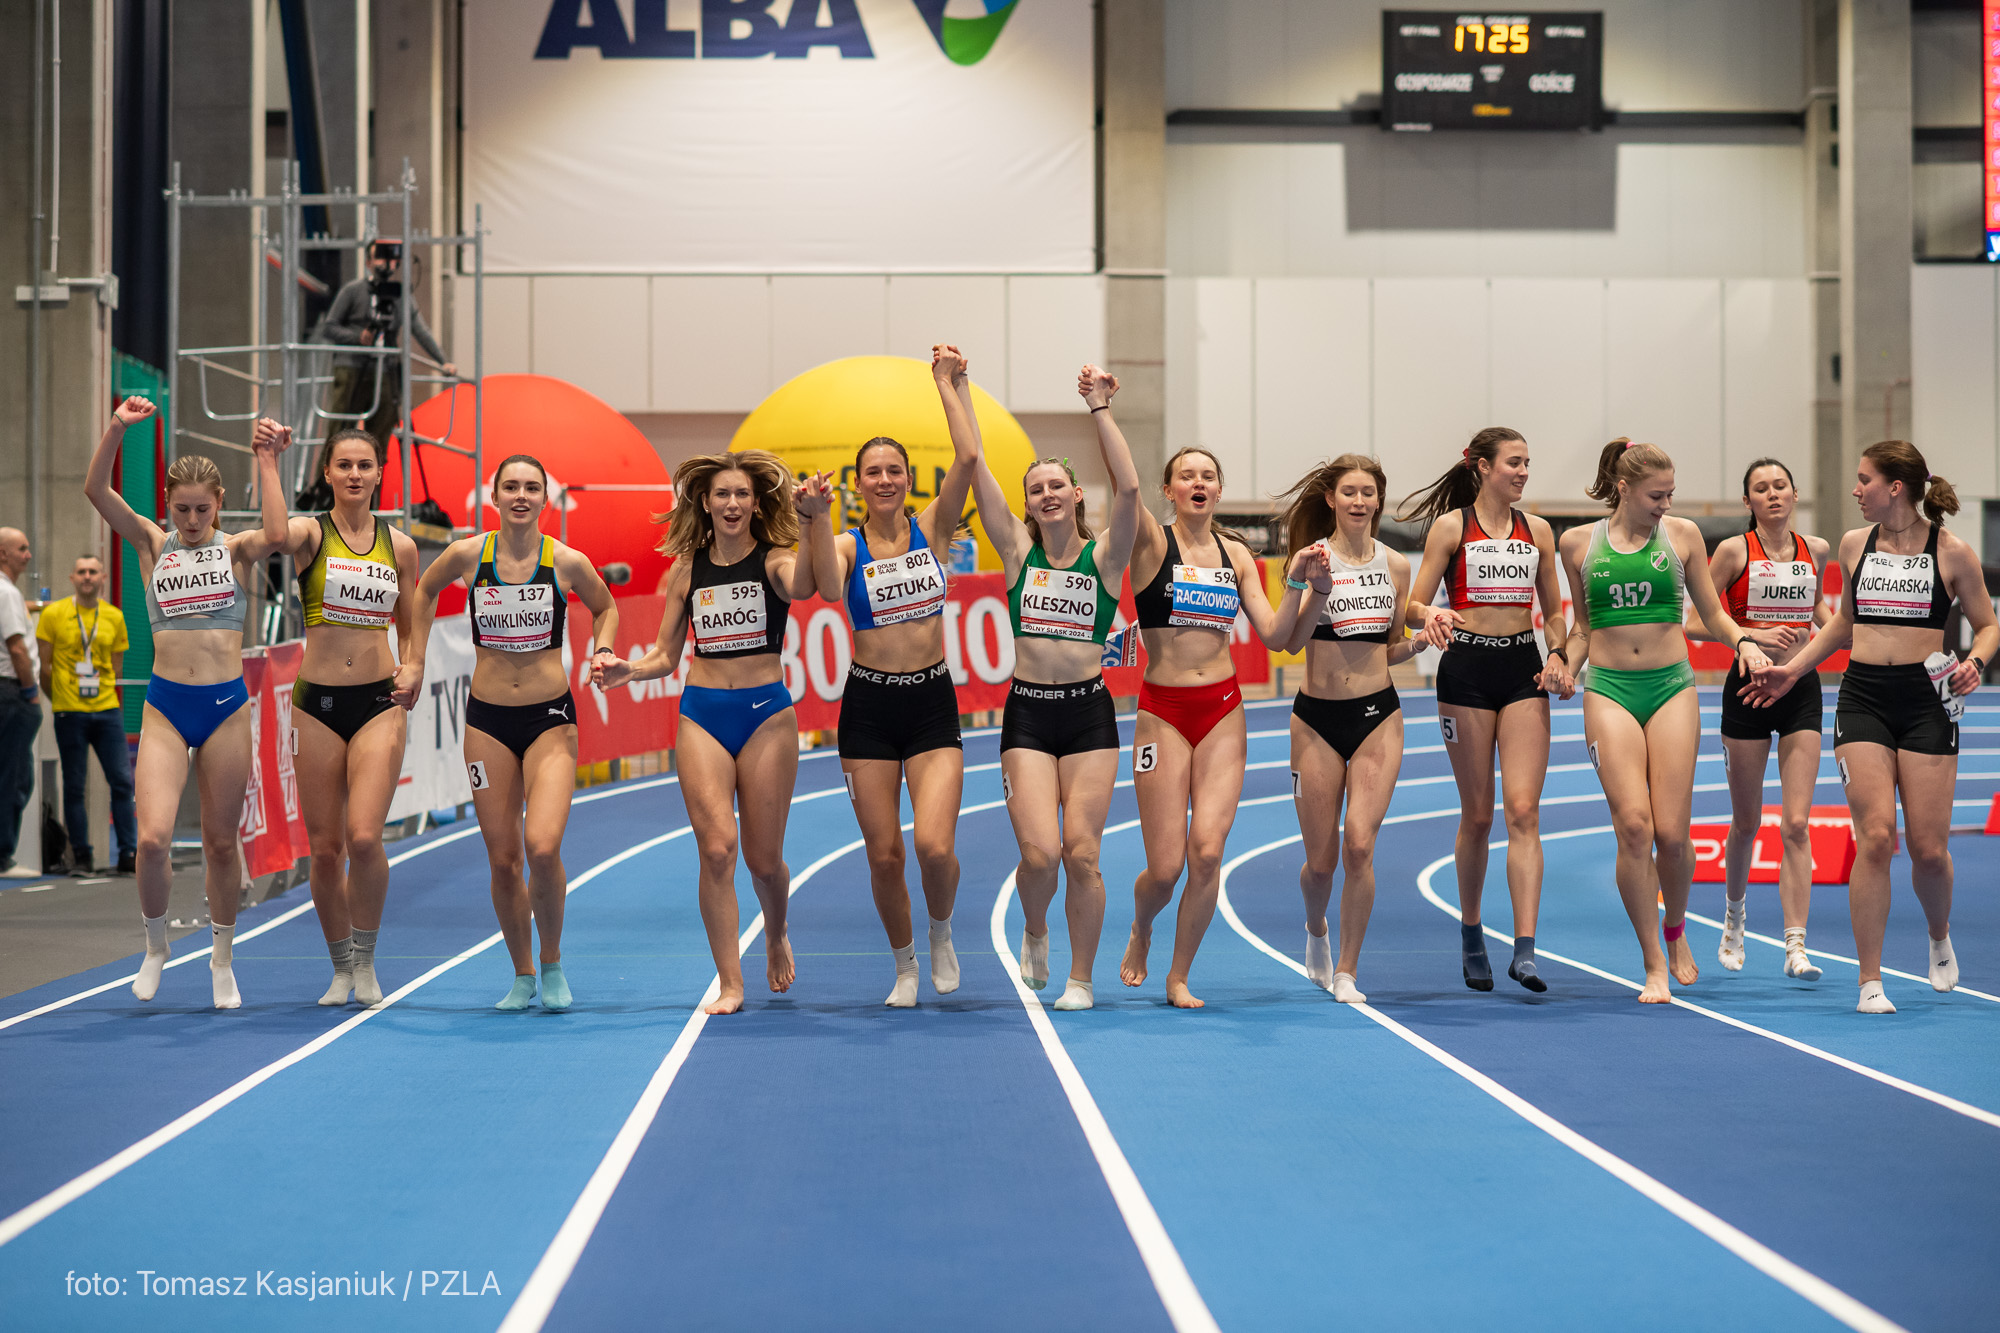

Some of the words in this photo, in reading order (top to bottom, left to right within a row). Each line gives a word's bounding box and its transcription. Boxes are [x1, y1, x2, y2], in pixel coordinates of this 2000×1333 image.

[533, 0, 877, 59] ALBA
[1506, 543, 1532, 554] 415
[163, 562, 180, 570] ORLEN
[329, 563, 362, 573] BODZIO
[877, 562, 898, 570] DOLNY
[905, 552, 930, 569] 802
[1903, 557, 1929, 570] 378
[366, 565, 396, 584] 1160
[1478, 564, 1529, 579] SIMON
[1792, 564, 1807, 576] 89
[157, 570, 231, 593] KWIATEK
[1065, 576, 1092, 591] 590
[1214, 572, 1237, 585] 594
[1332, 578, 1355, 586] DZIO
[1859, 577, 1930, 594] KUCHARSKA
[340, 583, 387, 604] MLAK
[518, 587, 546, 602] 137
[732, 585, 758, 600] 595
[876, 575, 939, 602] SZTUKA
[1609, 581, 1652, 609] 352
[1761, 585, 1807, 599] JUREK
[1176, 589, 1238, 611] RACZKOWSKA
[1328, 595, 1393, 614] KONIECZKO
[1498, 593, 1517, 601] ŚLĄSK
[166, 606, 187, 614] DOLNY
[189, 603, 210, 611] ŚLĄSK
[212, 600, 228, 608] 2024
[1022, 593, 1094, 617] KLESZNO
[1884, 607, 1904, 615] ŚLĄSK
[328, 612, 350, 621] DOLNY
[352, 615, 372, 624] ŚLĄSK
[479, 610, 550, 629] ĆWIKLIŃSKA
[701, 607, 758, 629] RARÓG
[881, 614, 905, 623] DOLNY
[906, 609, 926, 618] ŚLĄSK
[1340, 626, 1360, 634] DOLNY
[509, 643, 530, 651] ŚLĄSK
[1472, 636, 1511, 647] PRO
[779, 596, 1016, 706] BOIO
[1101, 636, 1120, 666] 59
[850, 664, 884, 683] NIKE
[885, 673, 925, 685] PRO
[1015, 685, 1065, 699] UNDER
[1443, 718, 1453, 740] 5
[1141, 746, 1152, 770] 5
[470, 764, 481, 788] 3
[1695, 838, 1817, 870] PL
